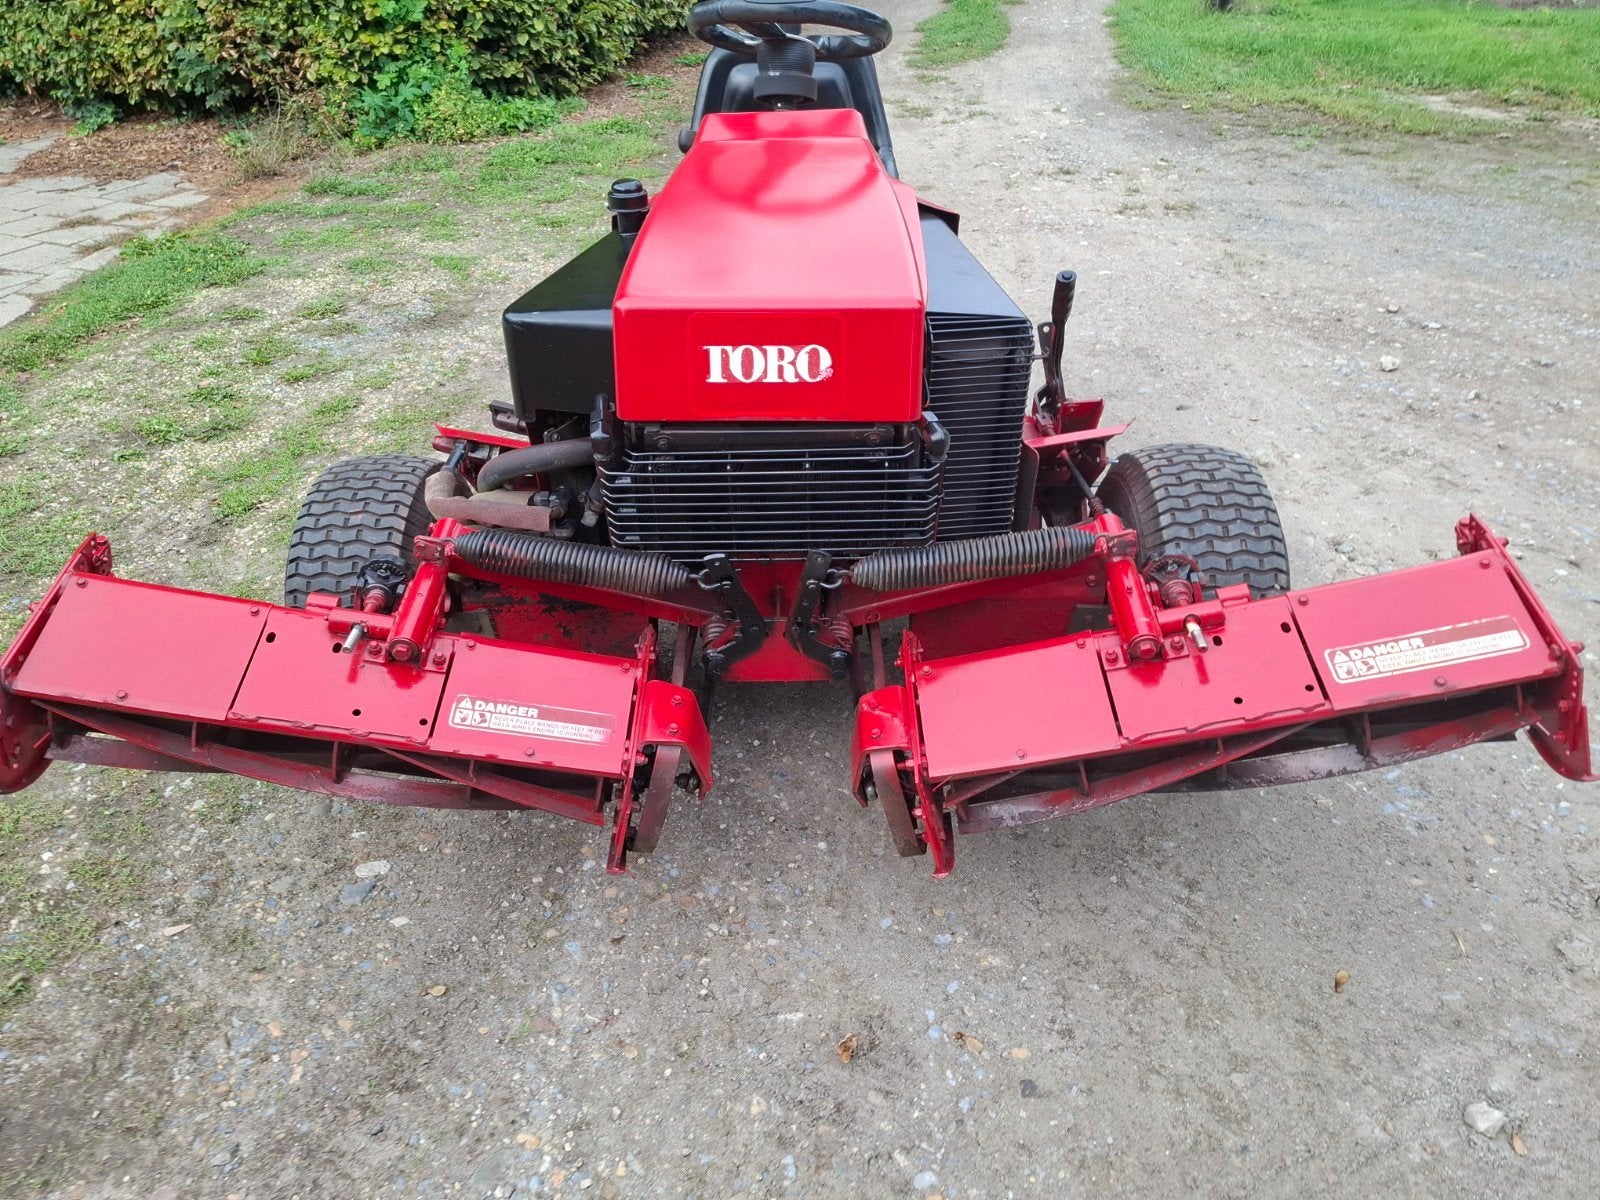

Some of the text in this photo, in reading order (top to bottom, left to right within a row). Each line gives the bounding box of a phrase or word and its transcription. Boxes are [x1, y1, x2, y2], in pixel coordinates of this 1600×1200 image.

[701, 343, 833, 383] TORO
[1348, 637, 1425, 661] DANGER
[474, 700, 539, 718] DANGER
[515, 718, 536, 727] PLACE
